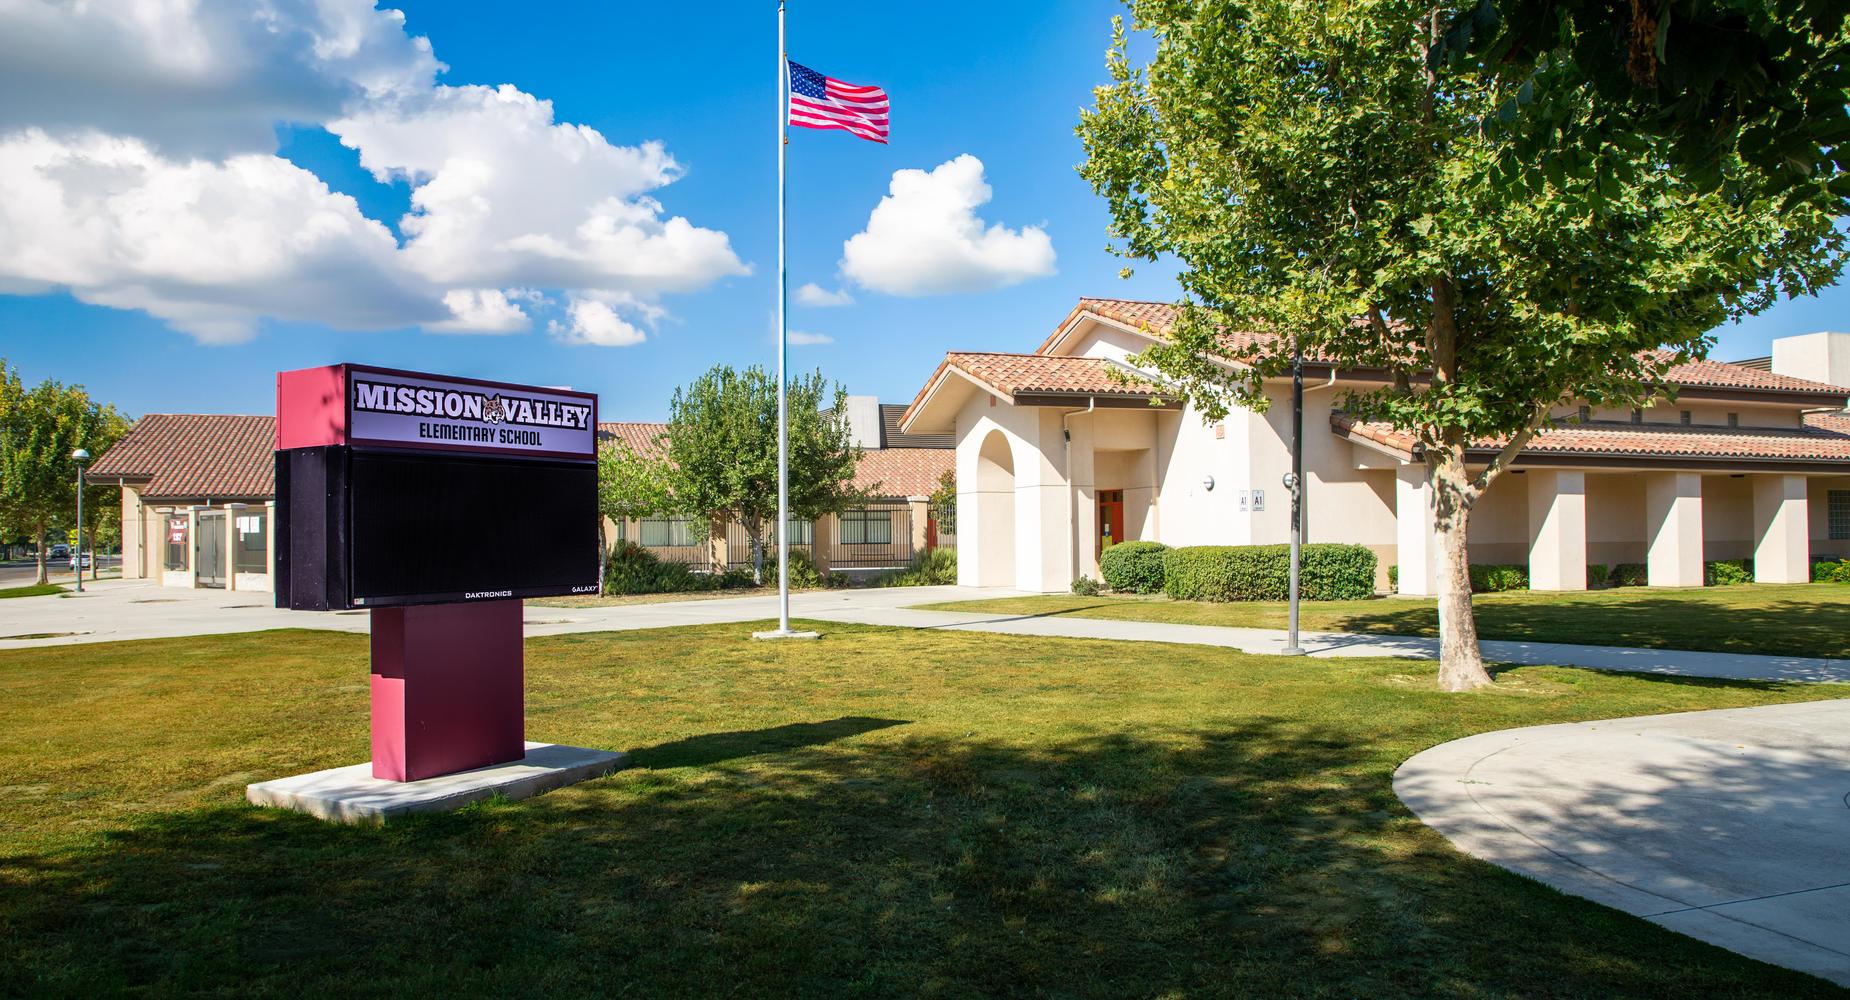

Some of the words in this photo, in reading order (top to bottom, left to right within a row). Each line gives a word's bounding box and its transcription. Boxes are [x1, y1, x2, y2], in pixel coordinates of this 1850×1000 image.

[355, 381, 482, 419] MISSION
[500, 399, 591, 430] VALLEY
[419, 423, 495, 443] ELEMENTARY
[499, 429, 542, 446] SCHOOL
[465, 590, 512, 599] DAKTRONICS
[571, 585, 598, 593] GALAXY
